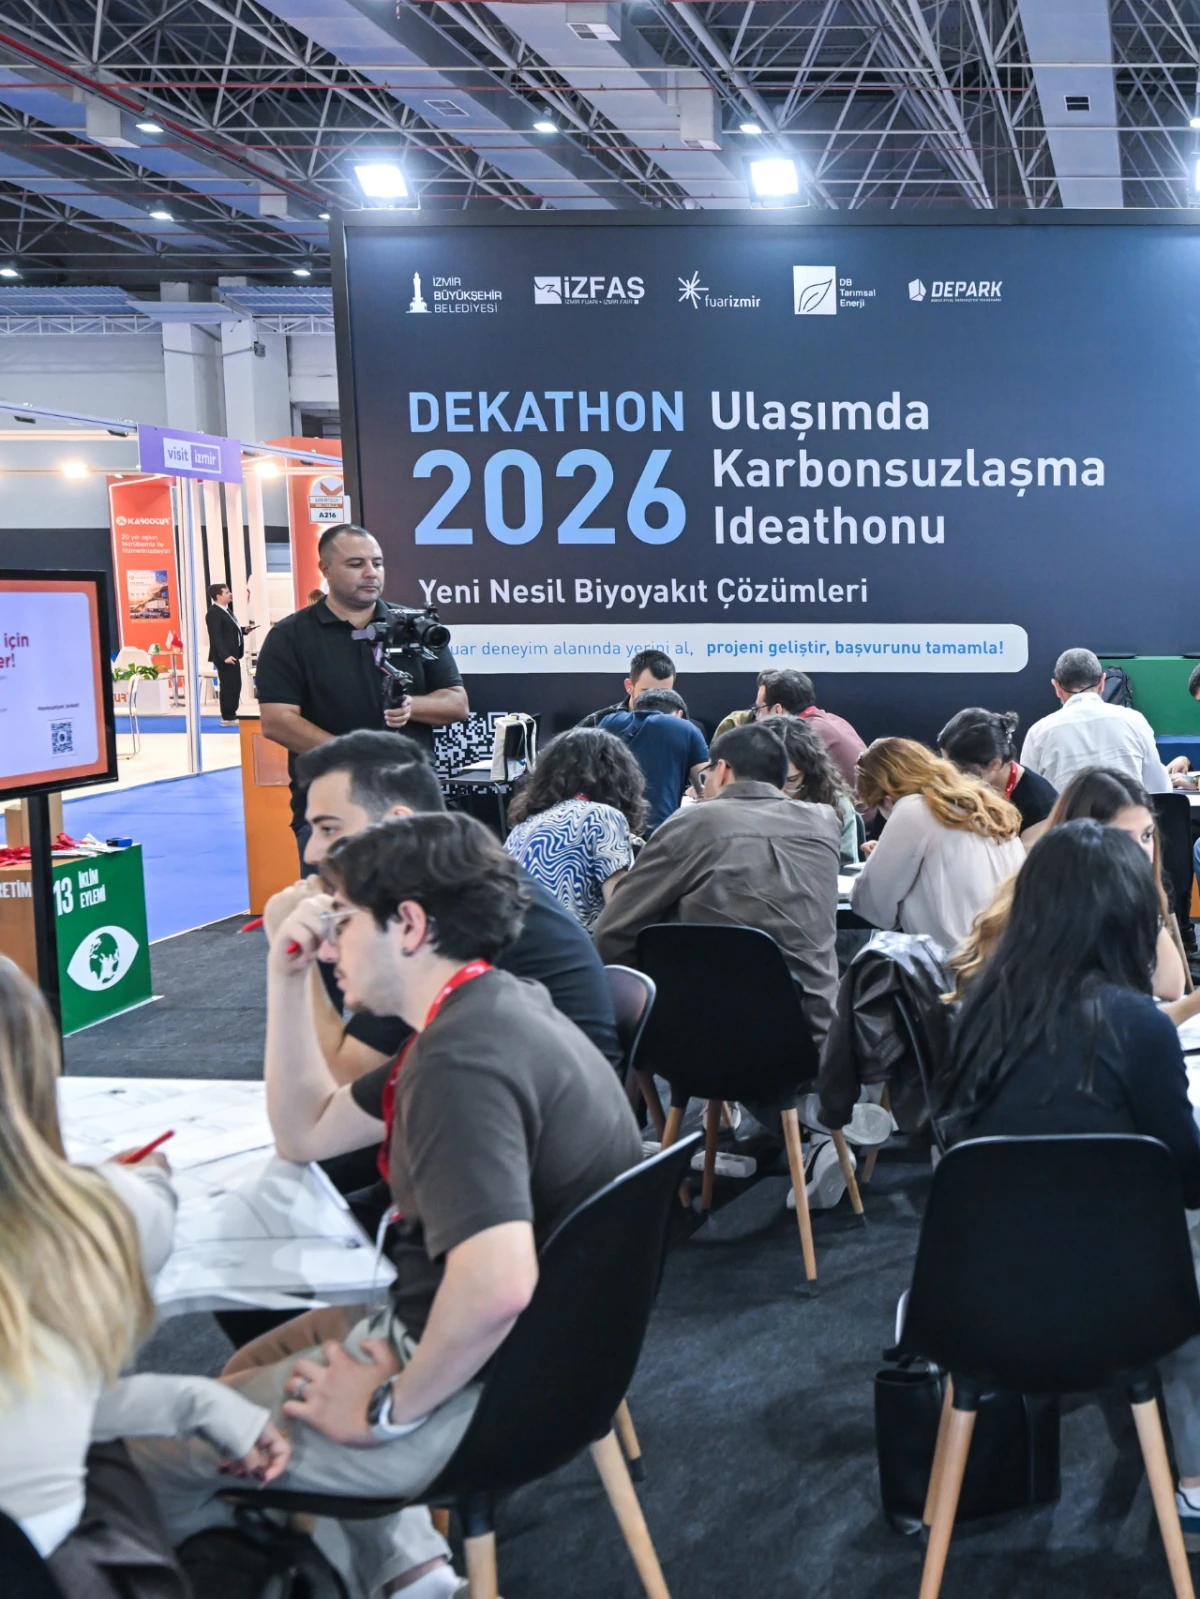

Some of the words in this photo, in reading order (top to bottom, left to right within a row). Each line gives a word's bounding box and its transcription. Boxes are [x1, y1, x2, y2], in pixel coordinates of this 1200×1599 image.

[432, 275, 461, 286] İZMİR
[839, 278, 852, 286] DB
[931, 281, 1003, 297] DEPARK
[433, 289, 502, 301] BÜYÜKŞEHİR
[839, 288, 876, 297] Tarımsal
[434, 302, 498, 313] BELEDİYESİ
[839, 299, 865, 309] Enerji
[409, 391, 684, 433] DEKATHON
[711, 391, 929, 441] Ulaşımda
[167, 446, 189, 462] visit
[194, 449, 216, 466] izmir
[713, 448, 1105, 497] Karbonsuzlaşma
[412, 448, 686, 545] 2026
[318, 511, 337, 519] A216
[715, 506, 945, 545] Ideathonu
[418, 579, 479, 604] Yeni
[490, 578, 566, 604] Nesil
[575, 578, 708, 609] Biyoyakıt
[717, 577, 868, 609] Çözümleri
[4, 632, 30, 651] için
[451, 643, 477, 656] uar
[482, 642, 548, 658] deneyim
[553, 641, 621, 655] alanında
[675, 641, 694, 656] al,
[706, 640, 764, 657] projeni
[768, 640, 830, 657] geliştir,
[835, 640, 921, 657] başvurunu
[926, 641, 1004, 654] tamamla!
[0, 653, 16, 668] er!
[53, 877, 74, 916] 13
[80, 884, 106, 908] EYLEMİ
